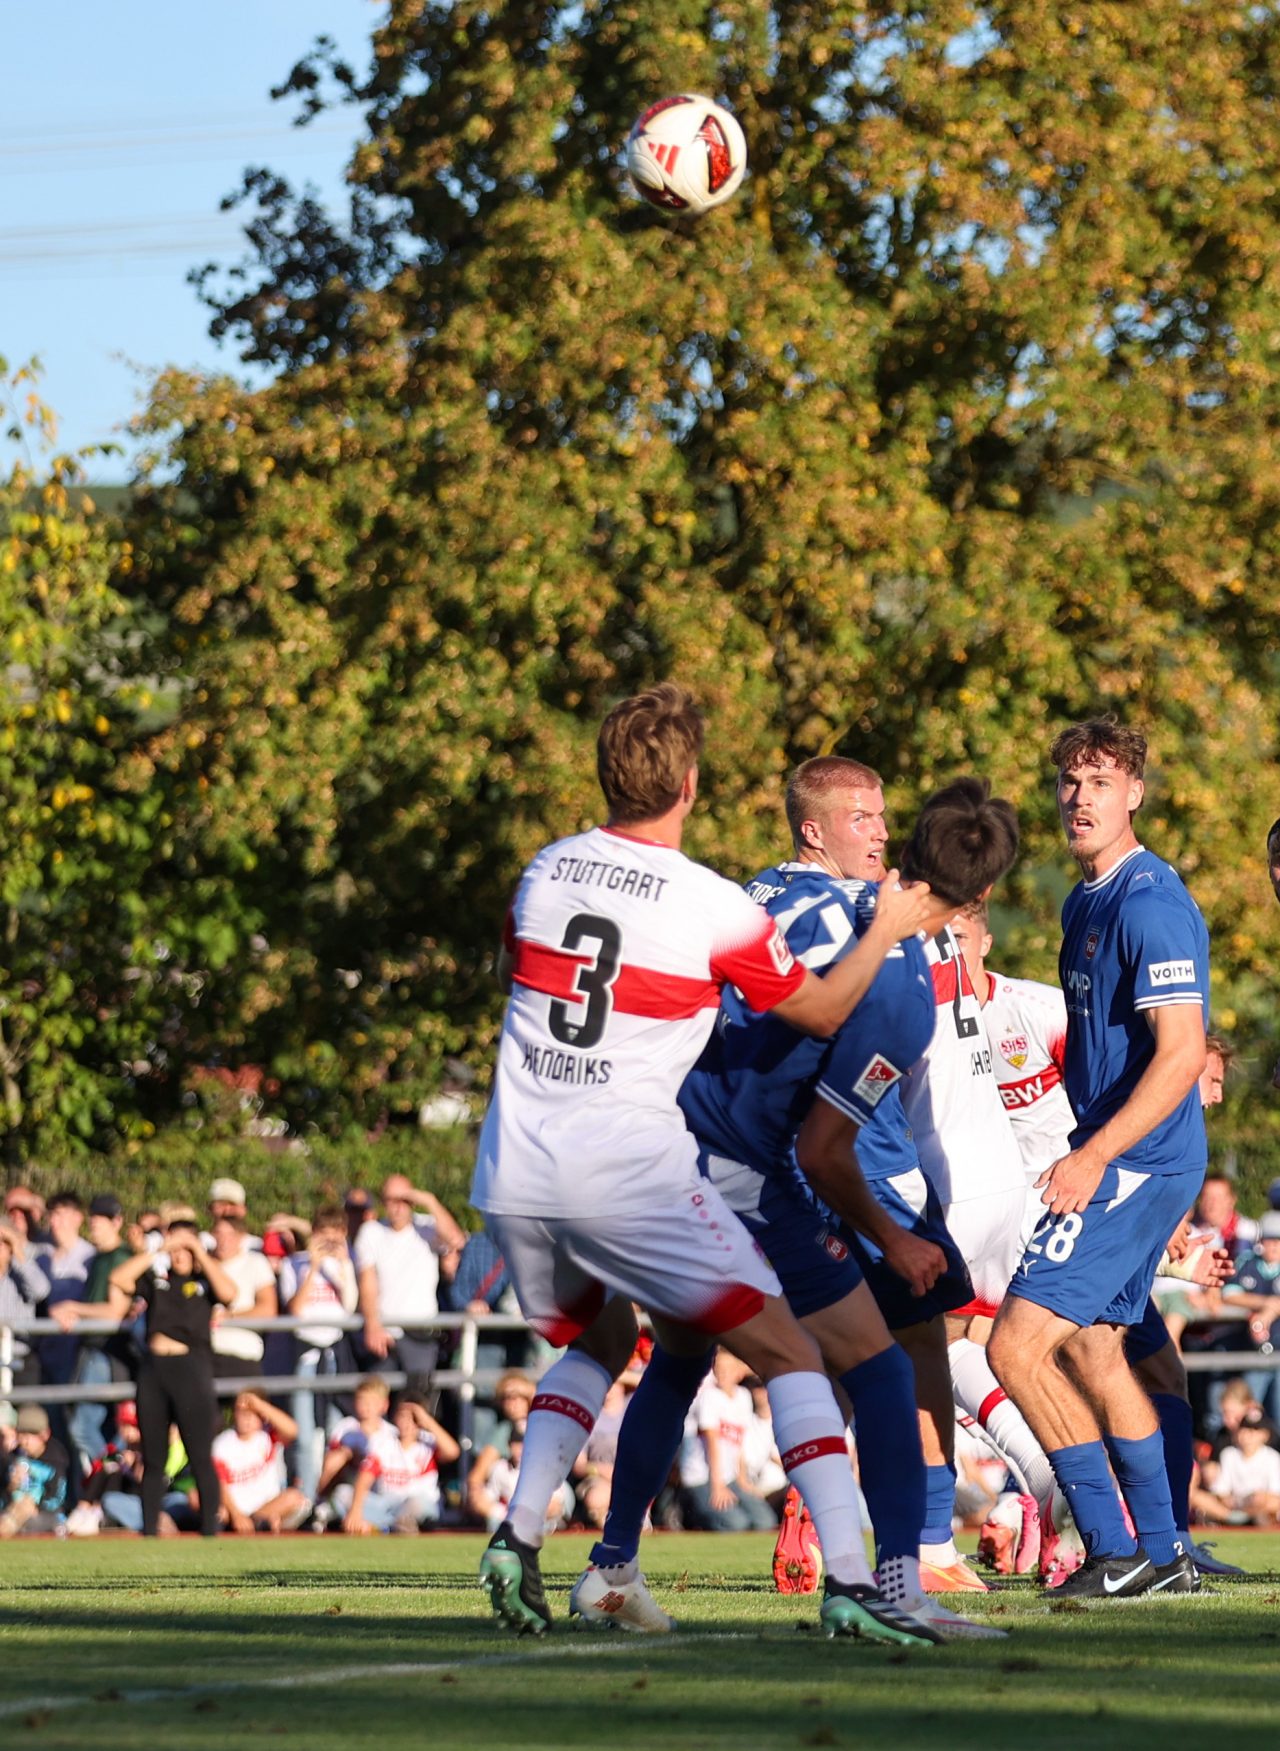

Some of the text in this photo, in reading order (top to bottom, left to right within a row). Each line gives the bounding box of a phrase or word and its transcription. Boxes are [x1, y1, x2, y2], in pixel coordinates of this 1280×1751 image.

[550, 856, 669, 902] STUTTGART
[548, 912, 621, 1049] 3
[1151, 966, 1193, 980] VOITH
[521, 1042, 614, 1086] HENDRIKS
[1027, 1211, 1084, 1263] 28
[537, 1397, 590, 1424] JAKO
